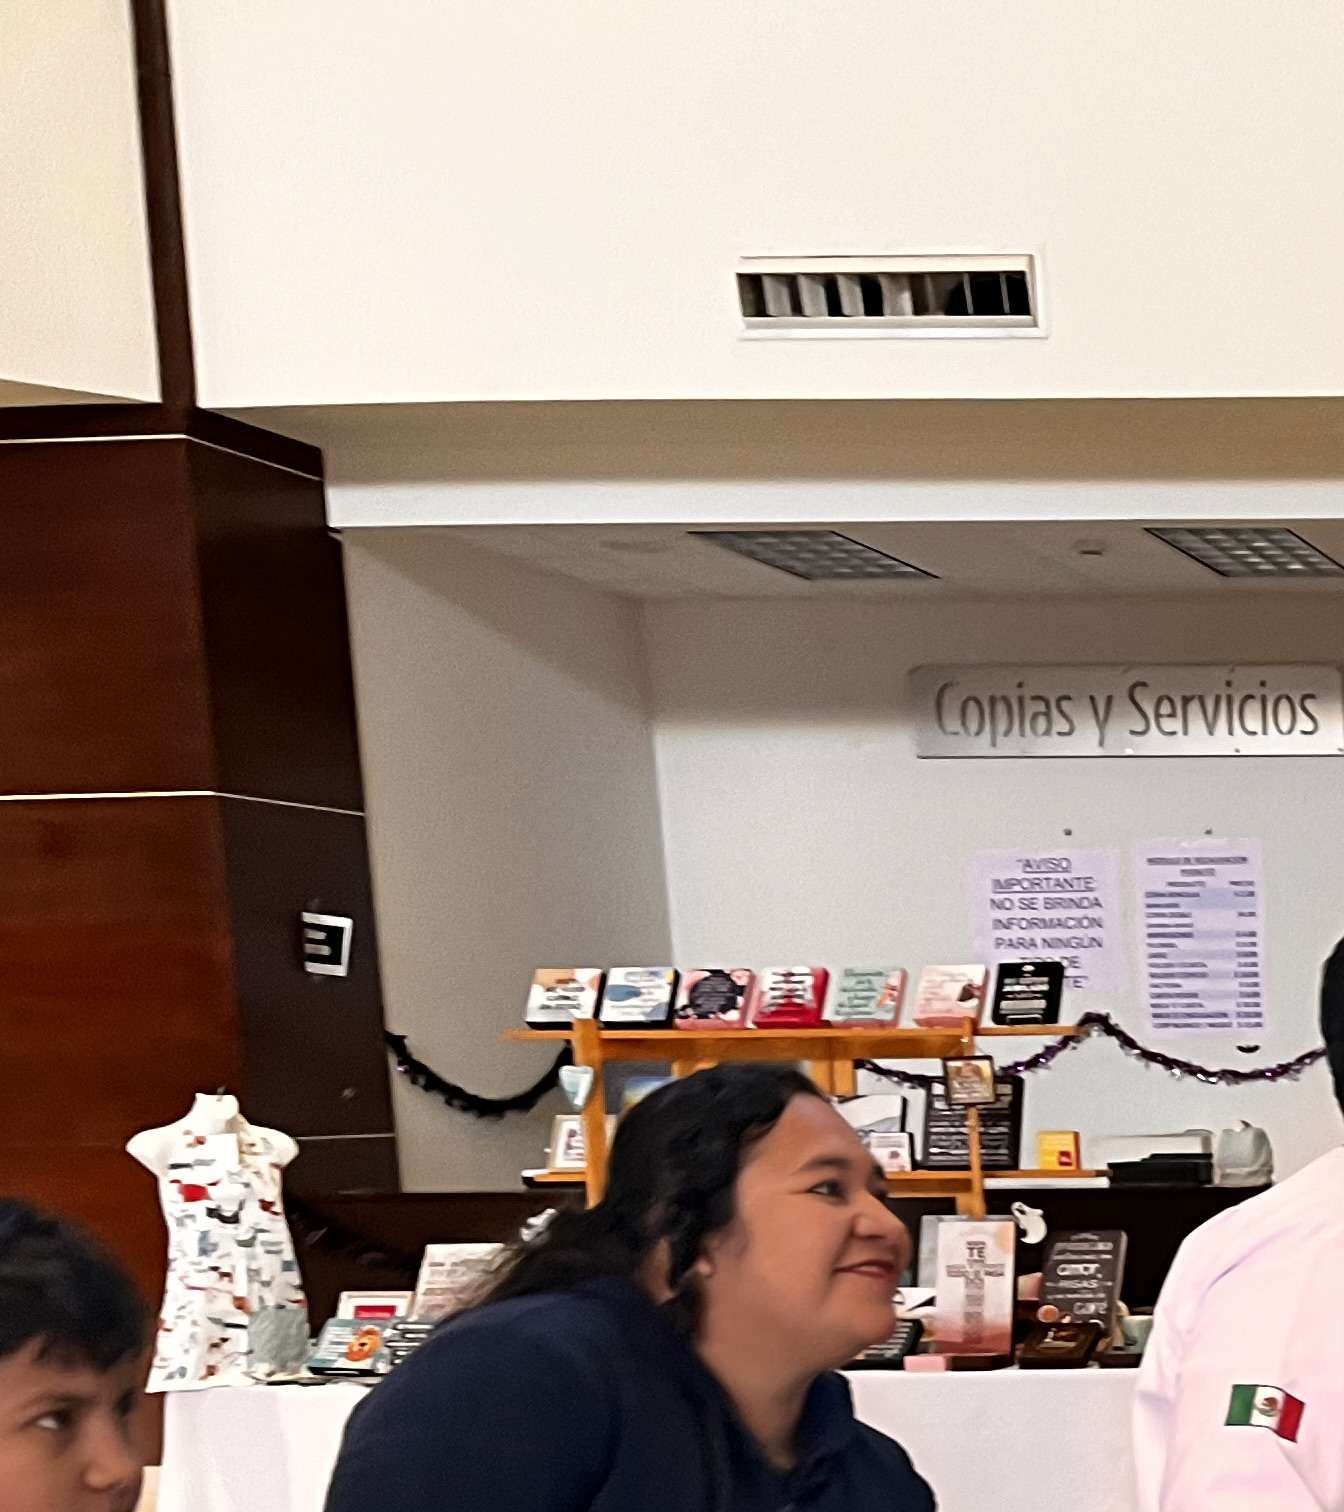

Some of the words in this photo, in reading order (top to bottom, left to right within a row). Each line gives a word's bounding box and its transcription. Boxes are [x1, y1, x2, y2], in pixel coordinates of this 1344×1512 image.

[935, 681, 1075, 747] Copias
[1088, 694, 1113, 747] y
[1128, 680, 1319, 737] Servicios
[992, 877, 1096, 891] IMPORTANTE
[990, 898, 1014, 910] NO
[1018, 897, 1039, 910] SE
[1043, 897, 1103, 910] BRINDA
[994, 937, 1038, 949] PARA
